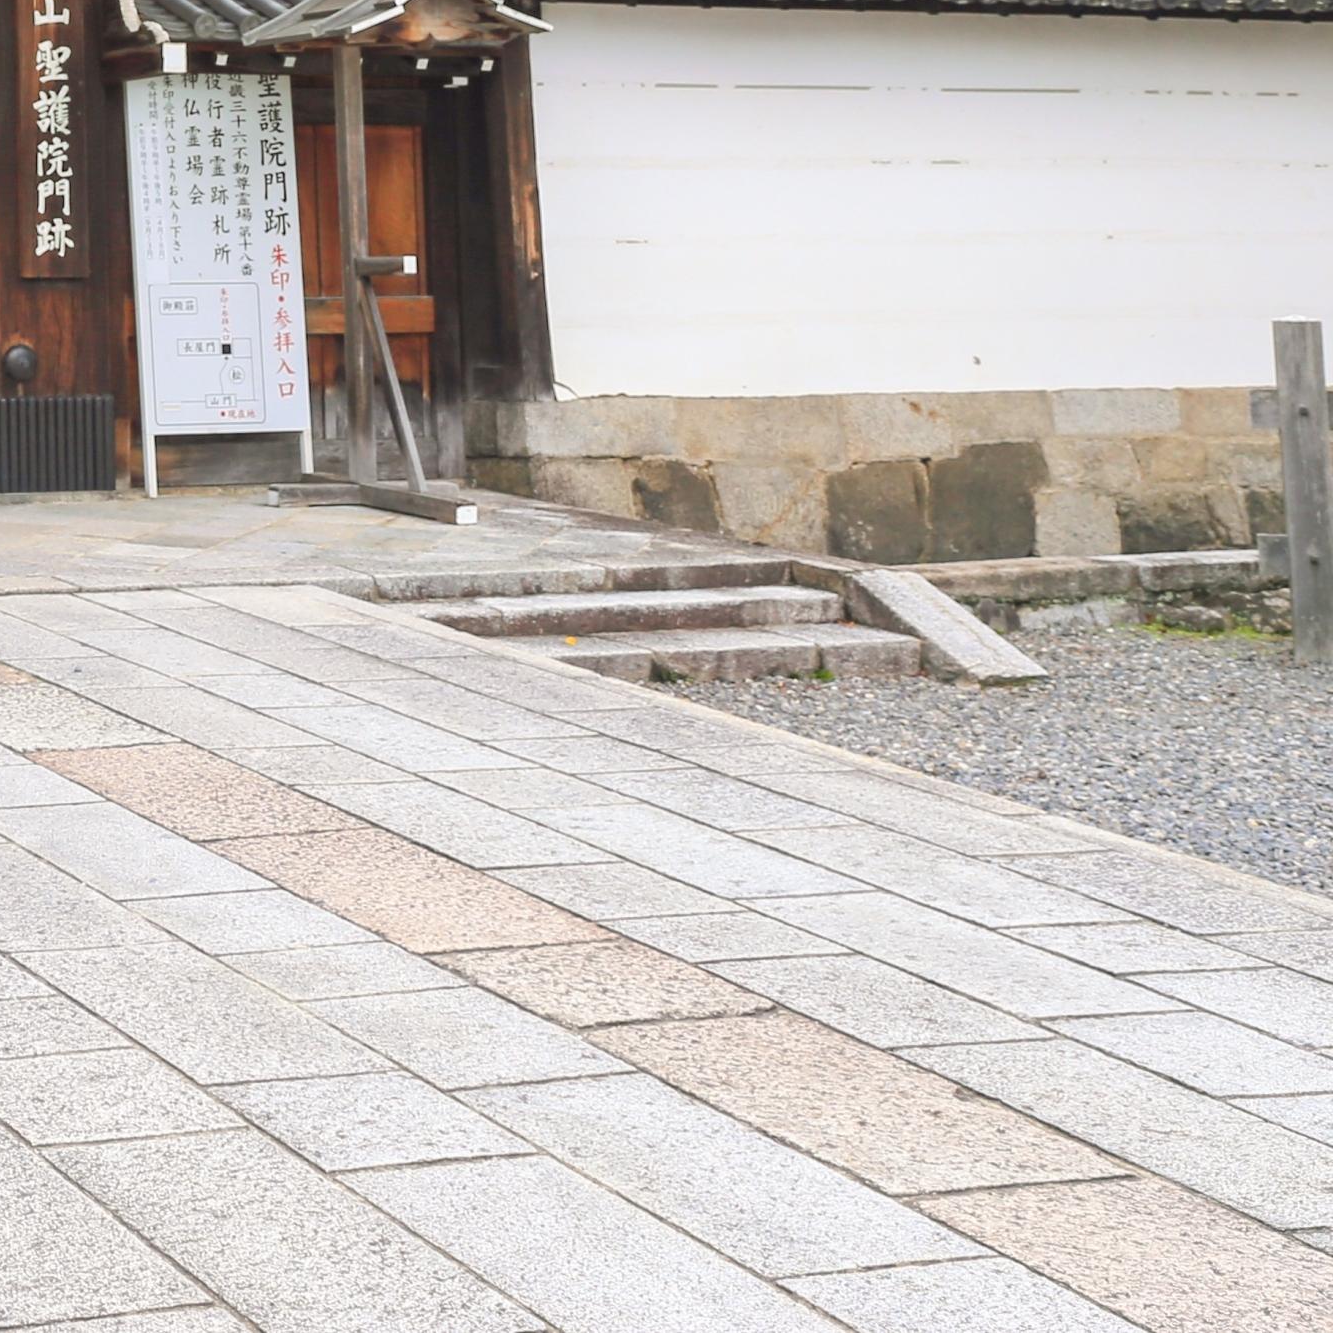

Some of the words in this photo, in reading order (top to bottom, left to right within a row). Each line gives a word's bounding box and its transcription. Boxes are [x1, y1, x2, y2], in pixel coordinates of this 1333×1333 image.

[33, 40, 75, 258] 聖護院門跡
[257, 74, 291, 236] 聖護院門跡
